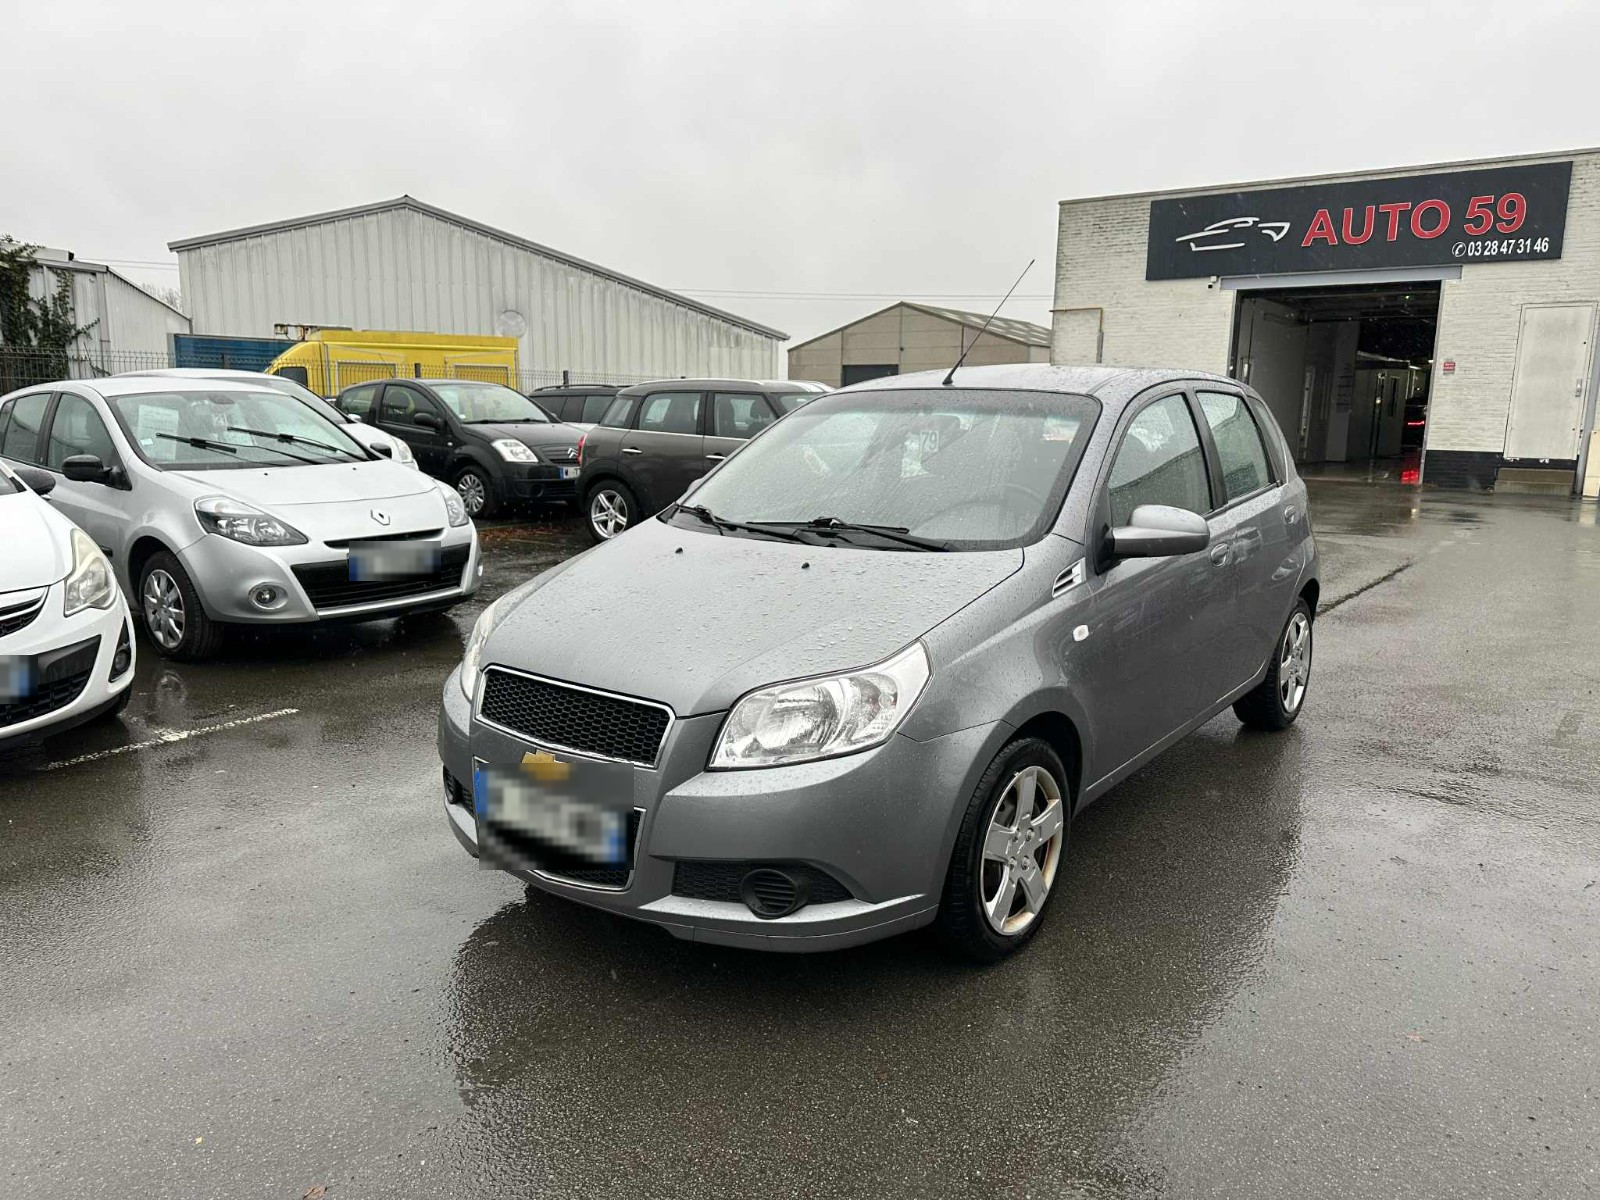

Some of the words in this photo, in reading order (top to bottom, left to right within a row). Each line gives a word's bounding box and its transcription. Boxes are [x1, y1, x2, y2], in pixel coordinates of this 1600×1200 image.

[1301, 199, 1451, 247] AUTO
[1463, 192, 1527, 236] 59
[1467, 241, 1482, 257] 03
[1483, 240, 1499, 256] 28
[1500, 239, 1515, 255] 47
[1516, 238, 1532, 254] 31
[1533, 237, 1550, 253] 46
